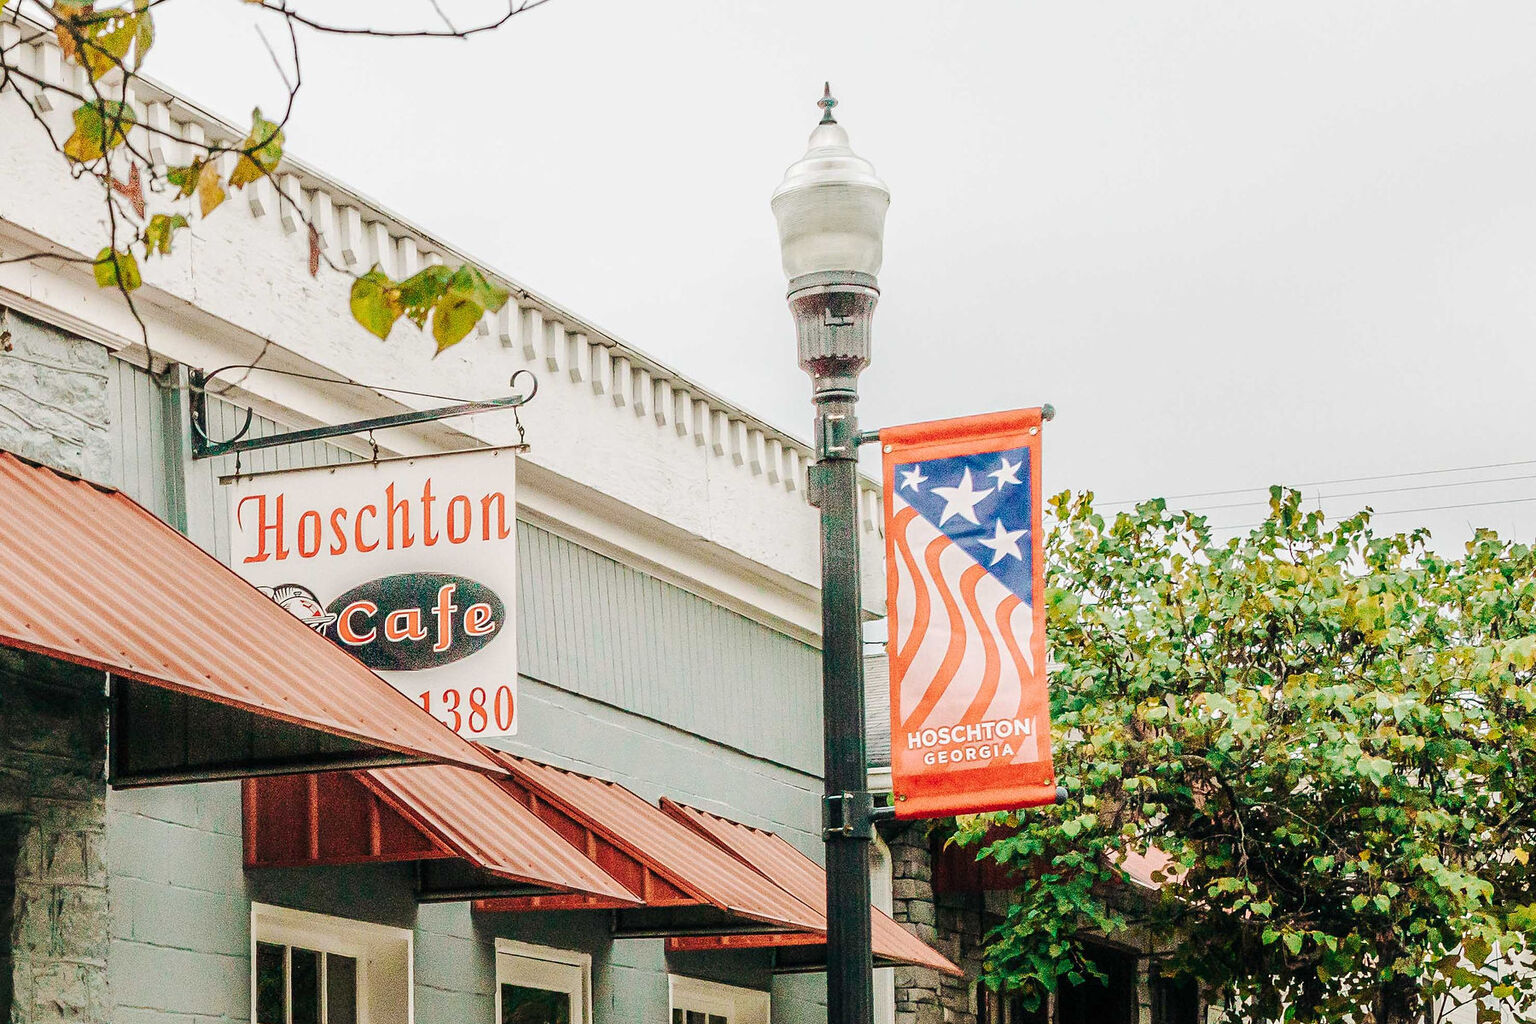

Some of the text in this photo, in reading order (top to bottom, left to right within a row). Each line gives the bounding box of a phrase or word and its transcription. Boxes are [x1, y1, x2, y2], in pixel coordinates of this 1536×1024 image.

[237, 477, 511, 564] Hoschton
[336, 583, 496, 653] Cafe
[907, 718, 1031, 750] HOSCHTON
[924, 743, 1015, 765] GEORGIA
